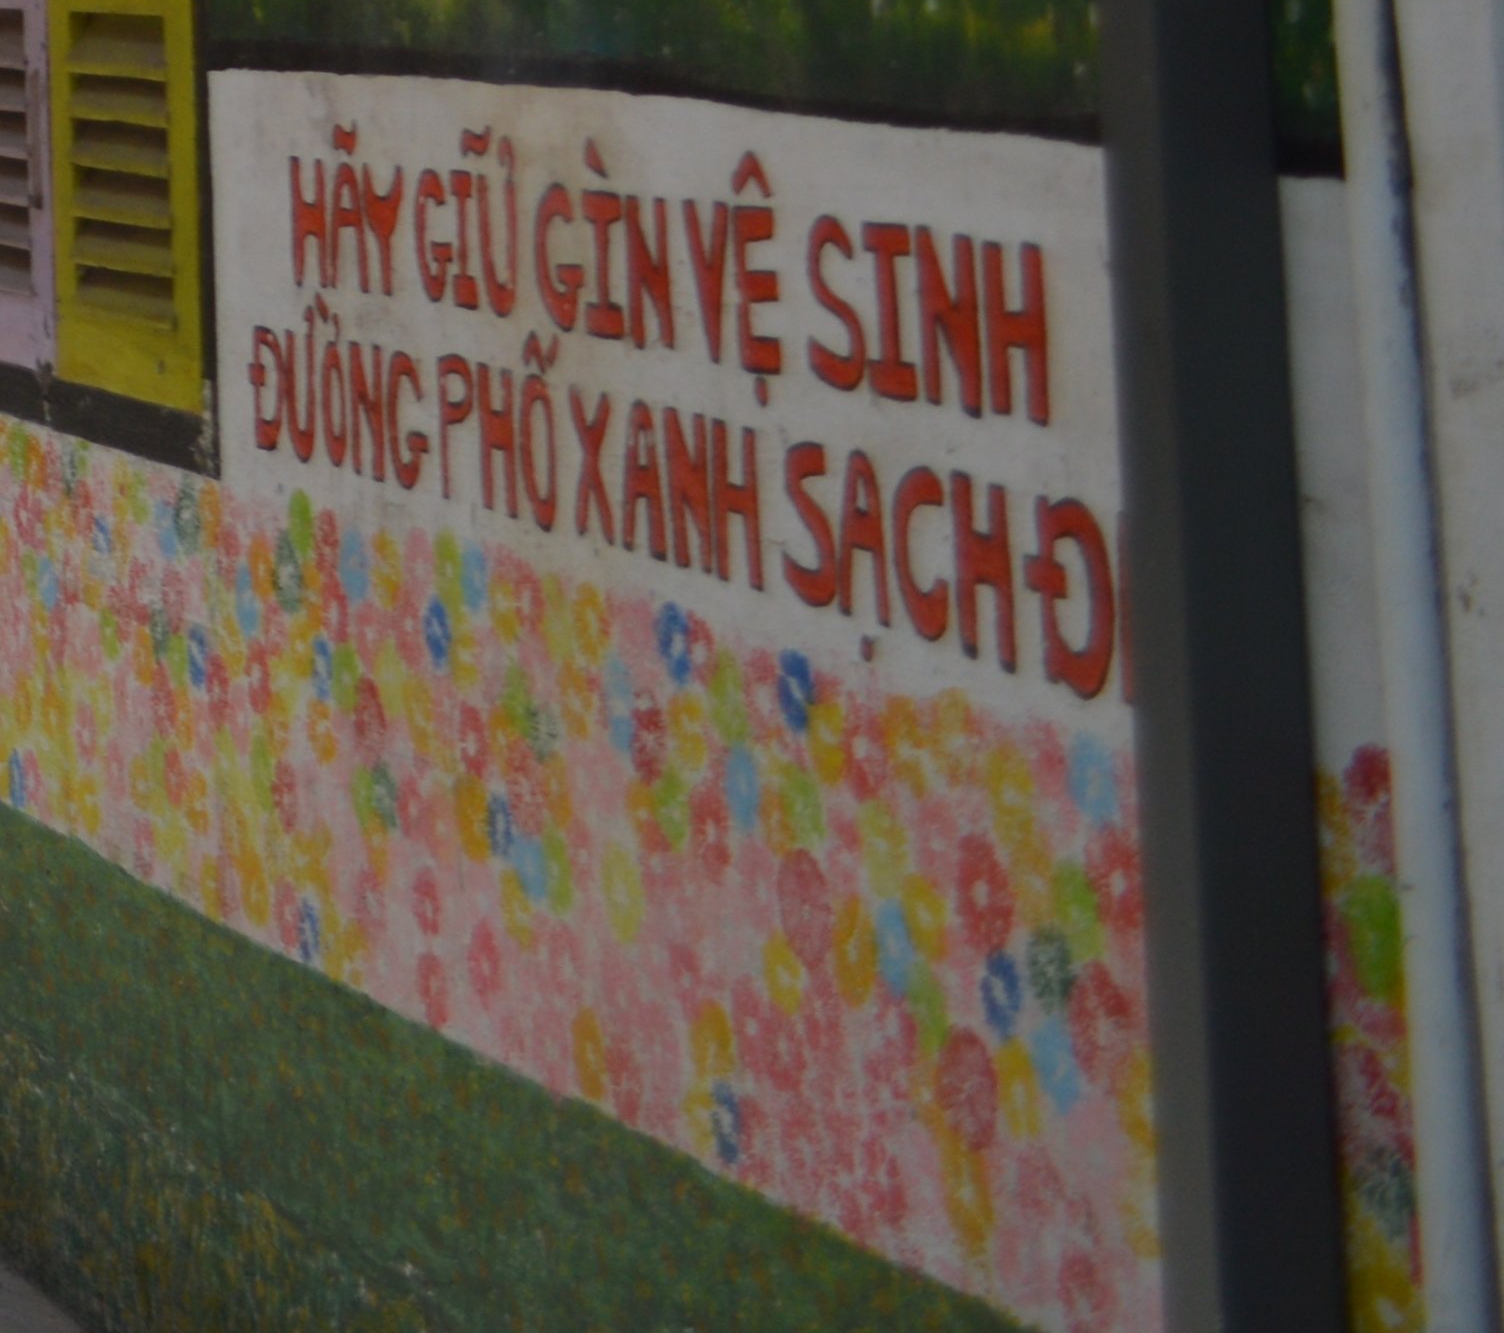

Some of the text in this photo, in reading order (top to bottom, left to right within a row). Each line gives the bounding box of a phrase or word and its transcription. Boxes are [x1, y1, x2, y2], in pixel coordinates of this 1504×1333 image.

[289, 120, 1050, 427] HÃY GIỮ GÌN VỆ SINH
[248, 292, 429, 490] ĐƯỜNG
[436, 330, 559, 532] PHỐ
[569, 384, 765, 592] XANH
[782, 441, 1017, 673] SẠCH
